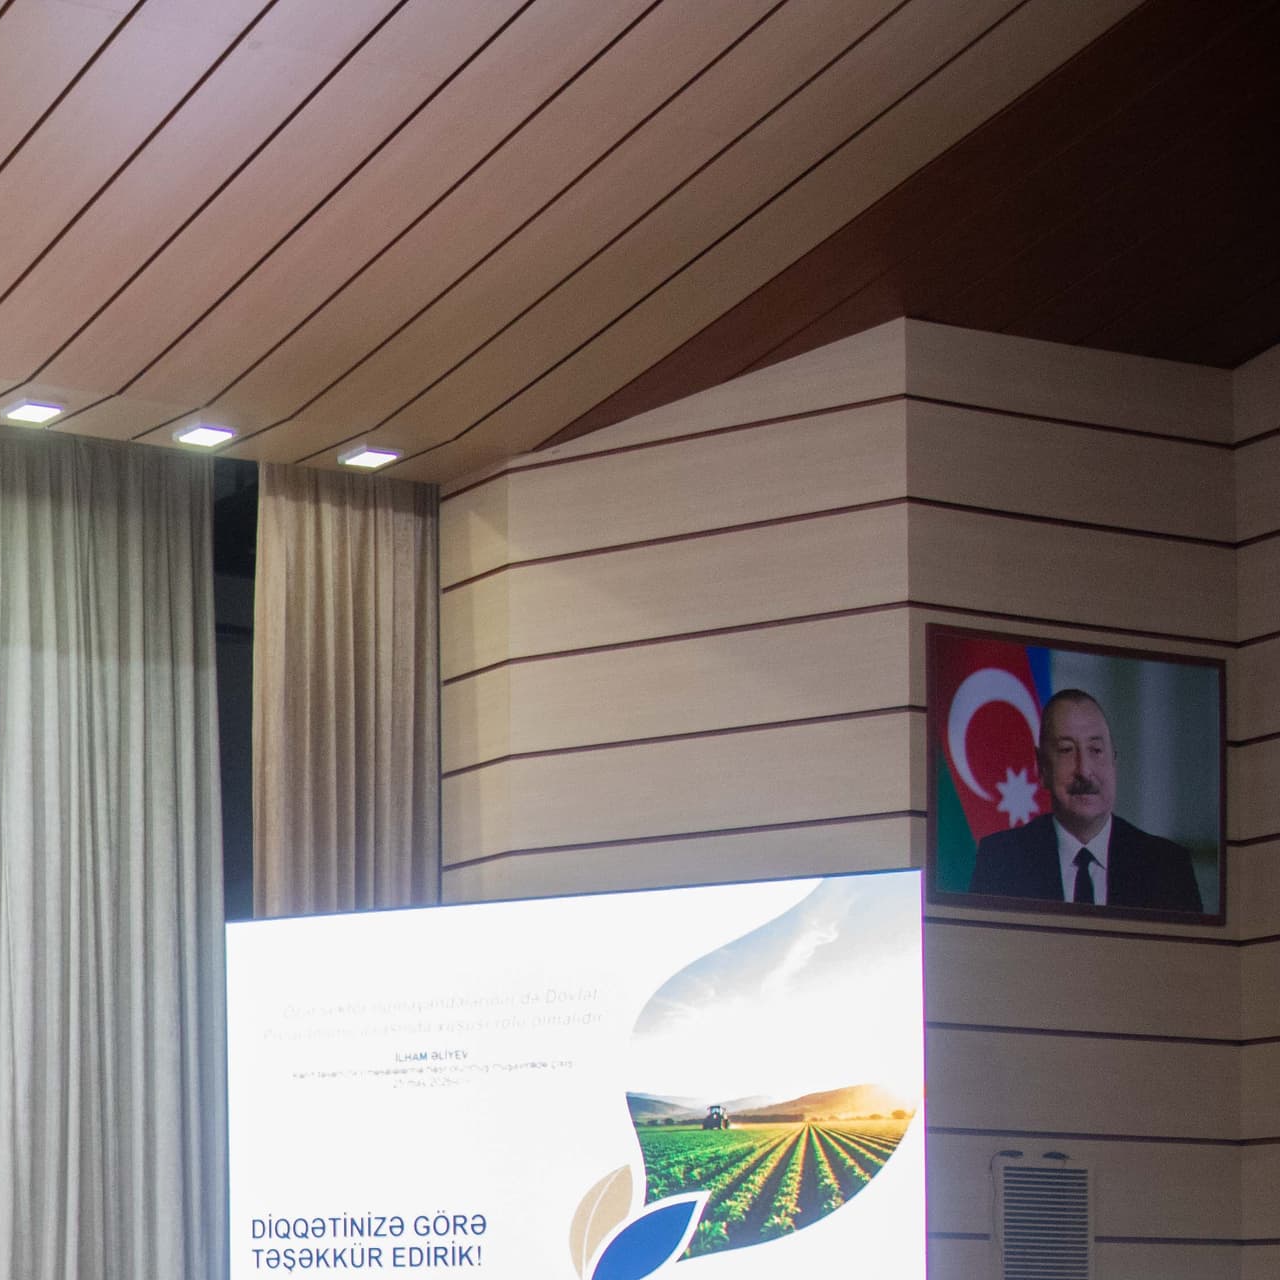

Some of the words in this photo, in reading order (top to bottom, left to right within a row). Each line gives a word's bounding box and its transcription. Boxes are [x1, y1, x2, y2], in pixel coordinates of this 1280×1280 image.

[251, 1211, 405, 1240] DİQQƏTİNİZƏ
[413, 1209, 488, 1237] GÖRƏ
[251, 1242, 384, 1273] TƏŞƏKKÜR
[392, 1240, 482, 1268] EDİRİK!
